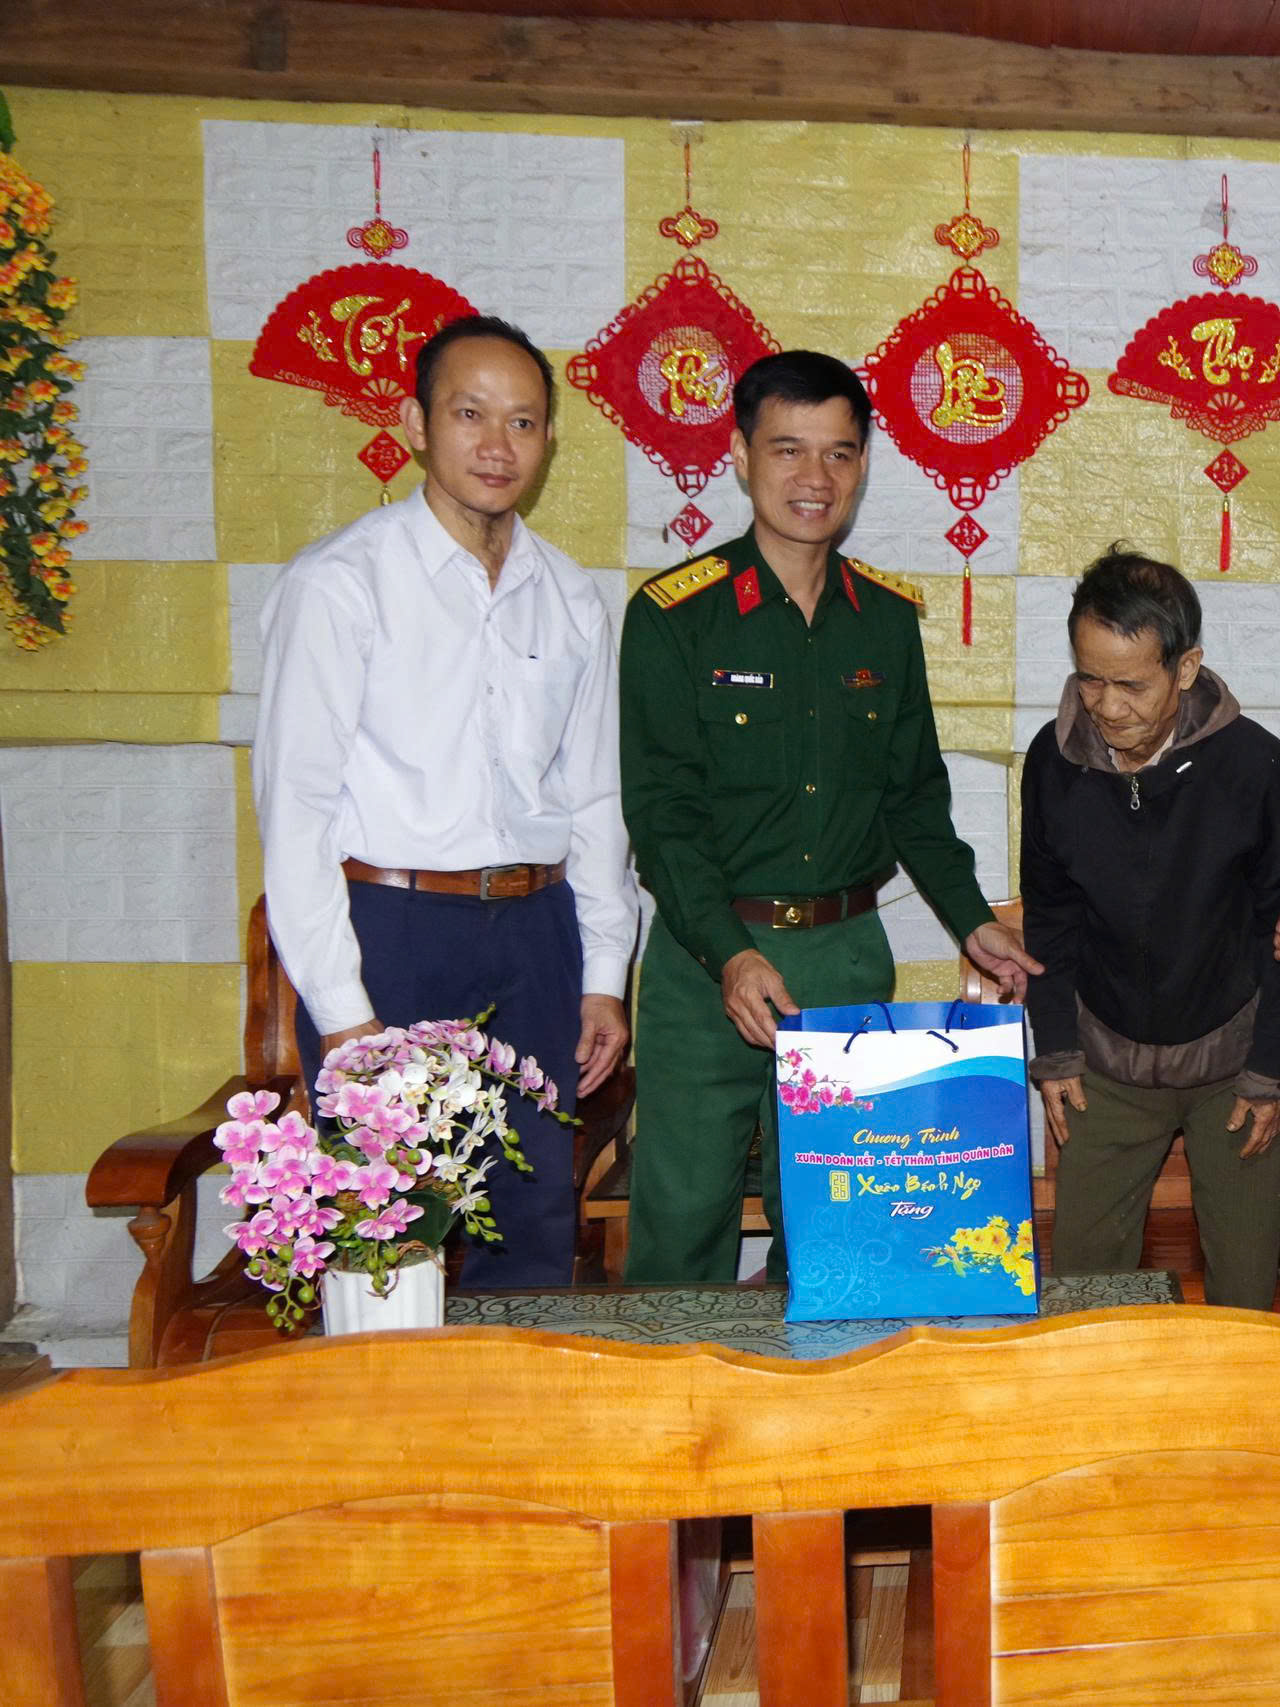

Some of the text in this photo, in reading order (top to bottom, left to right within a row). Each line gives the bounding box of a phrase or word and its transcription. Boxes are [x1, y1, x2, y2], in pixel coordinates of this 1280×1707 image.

[918, 1126, 961, 1144] Trình
[795, 1150, 823, 1163] XUÂN
[825, 1152, 854, 1166] ĐOÀN
[856, 1150, 875, 1166] KẾT
[884, 1150, 902, 1166] TẾT
[936, 1151, 960, 1166] TÌNH
[961, 1146, 991, 1163] QUÂN
[991, 1142, 1014, 1158] DÂN
[857, 1172, 900, 1197] Xuân
[890, 1200, 935, 1220] Tặng
